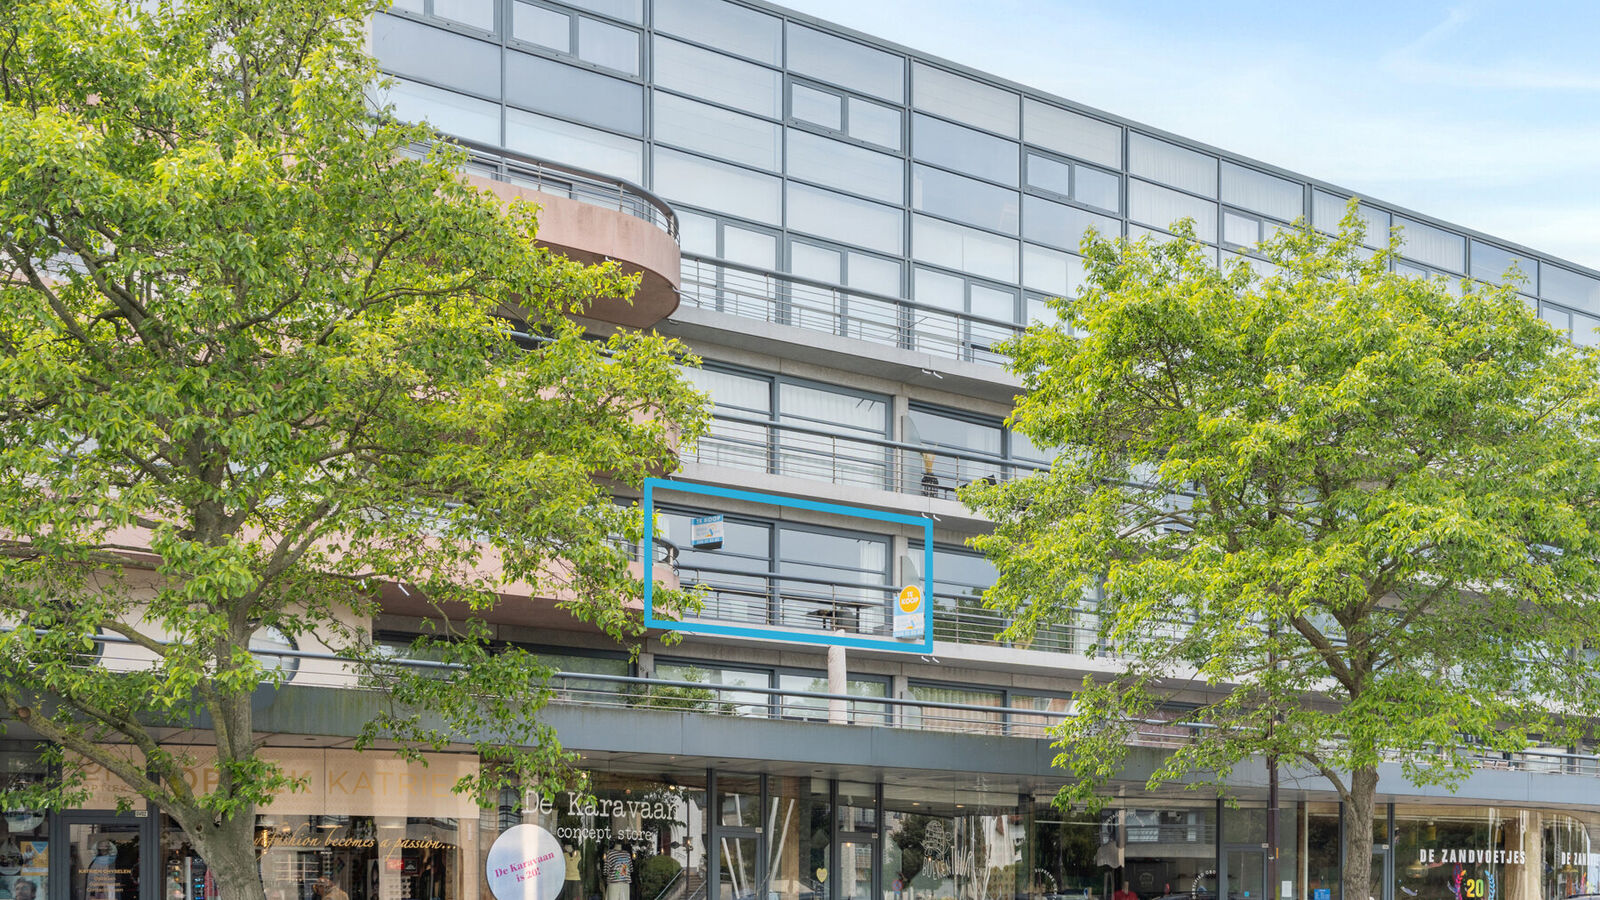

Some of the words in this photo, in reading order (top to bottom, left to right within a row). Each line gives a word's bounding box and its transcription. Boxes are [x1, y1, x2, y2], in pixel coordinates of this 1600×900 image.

[703, 514, 721, 523] KOOP
[900, 596, 919, 605] KOOP
[521, 790, 553, 815] De
[567, 792, 679, 820] Karavaan
[324, 825, 375, 848] becomes
[380, 838, 389, 848] a
[557, 824, 612, 843] concept
[617, 828, 653, 841] store
[494, 867, 508, 878] De
[509, 852, 555, 872] Karavaan
[1420, 849, 1435, 863] DE
[1441, 849, 1526, 865] ZANDVOETJES
[1561, 851, 1571, 865] DE
[516, 873, 525, 882] is
[1466, 879, 1484, 897] 20
